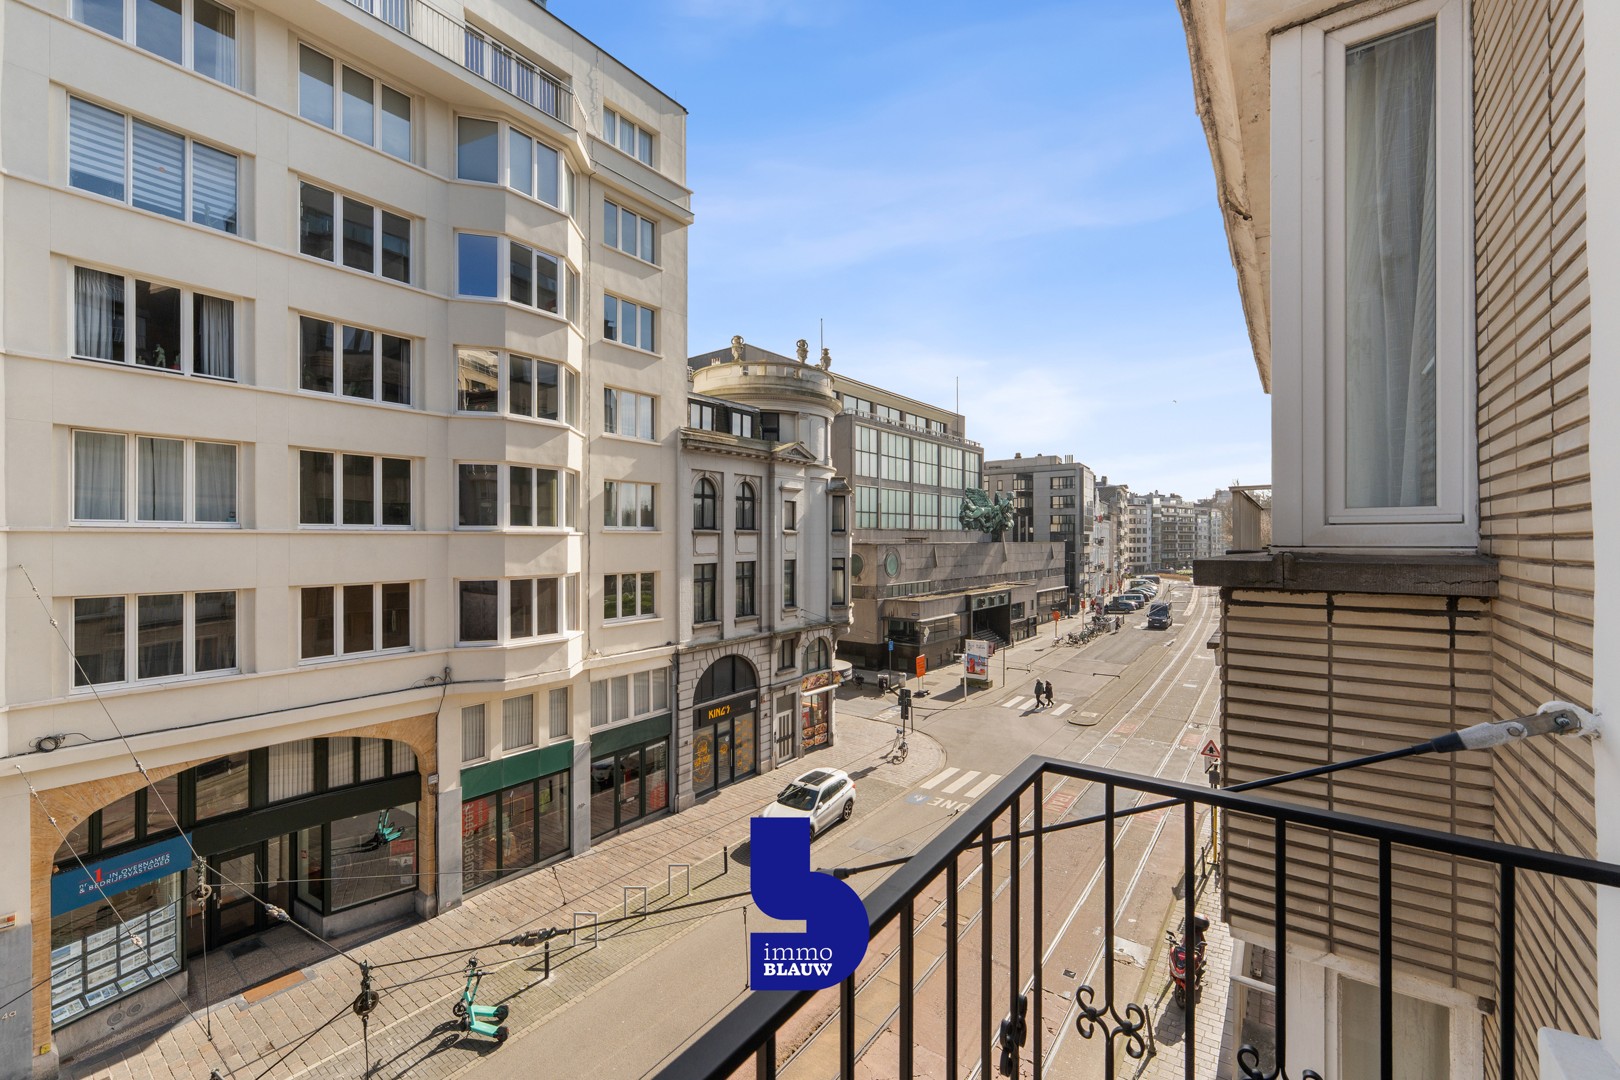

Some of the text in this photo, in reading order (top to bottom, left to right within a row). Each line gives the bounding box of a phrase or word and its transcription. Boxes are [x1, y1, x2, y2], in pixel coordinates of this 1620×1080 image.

[708, 704, 731, 720] KING'S
[926, 796, 971, 811] ONE
[109, 871, 118, 879] IN
[121, 853, 170, 873] OVERNAMES
